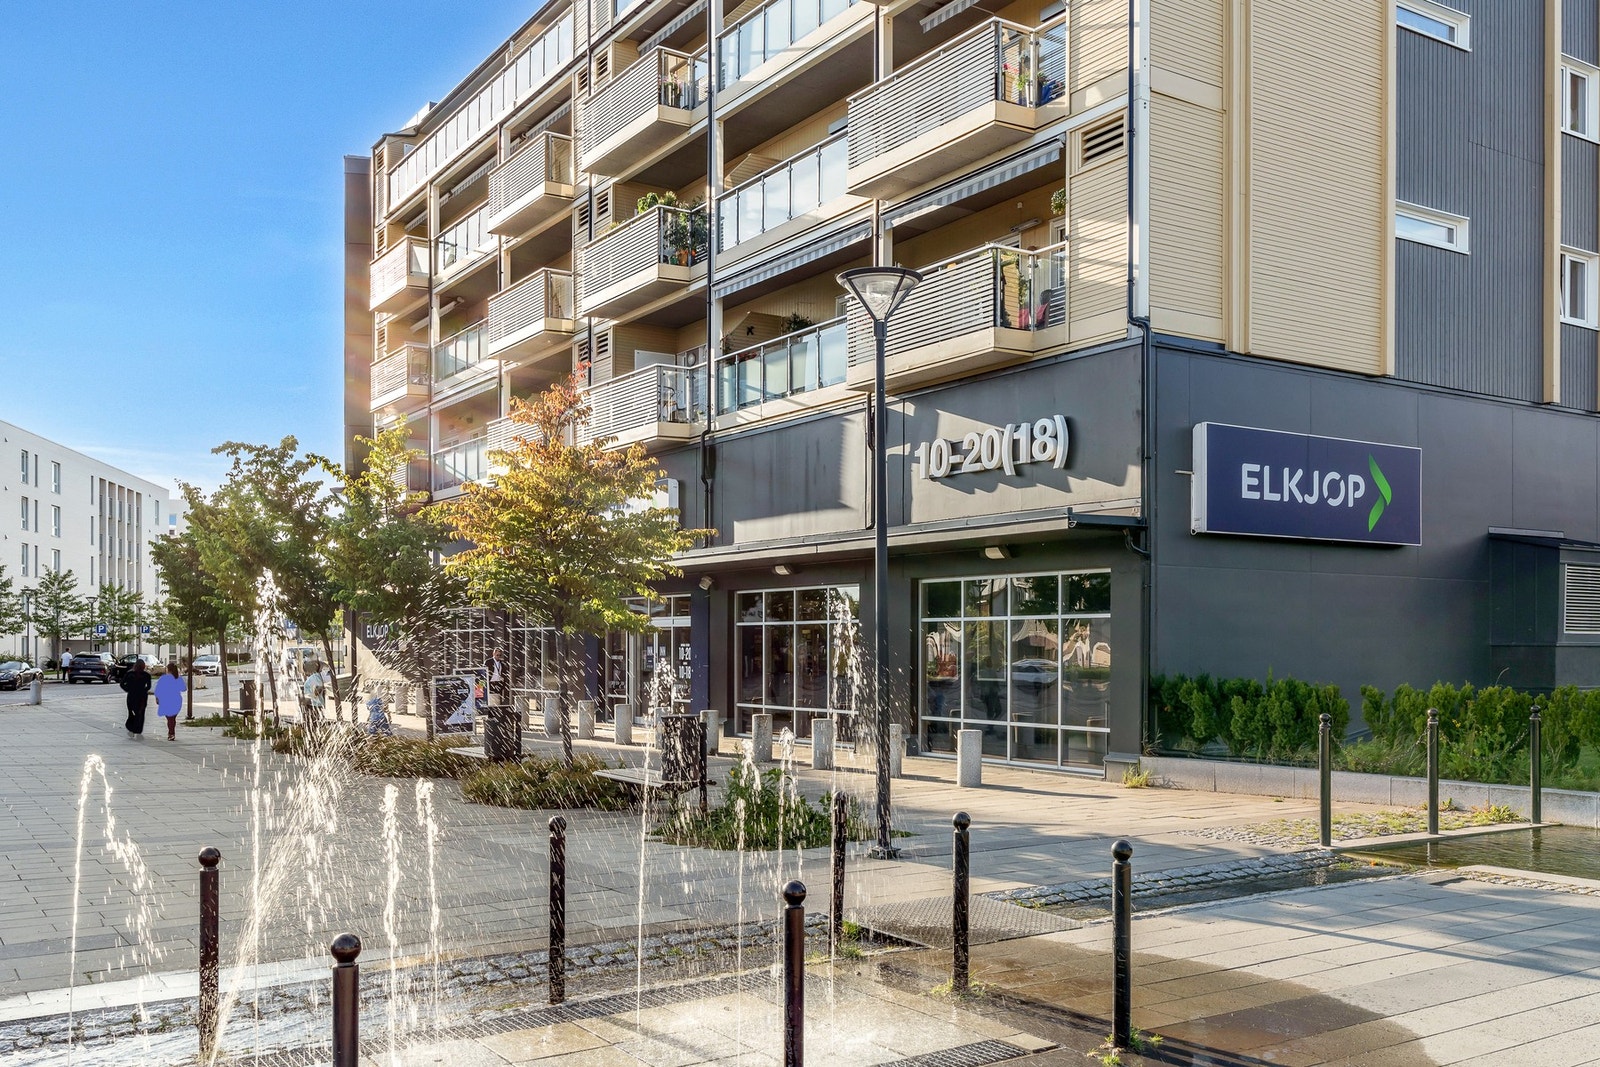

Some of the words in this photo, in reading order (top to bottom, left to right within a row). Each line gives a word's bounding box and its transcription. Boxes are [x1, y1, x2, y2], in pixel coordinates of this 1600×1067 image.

[915, 414, 1069, 479] 10-20(18)
[1241, 463, 1366, 508] ELKJOP
[98, 625, 105, 633] P
